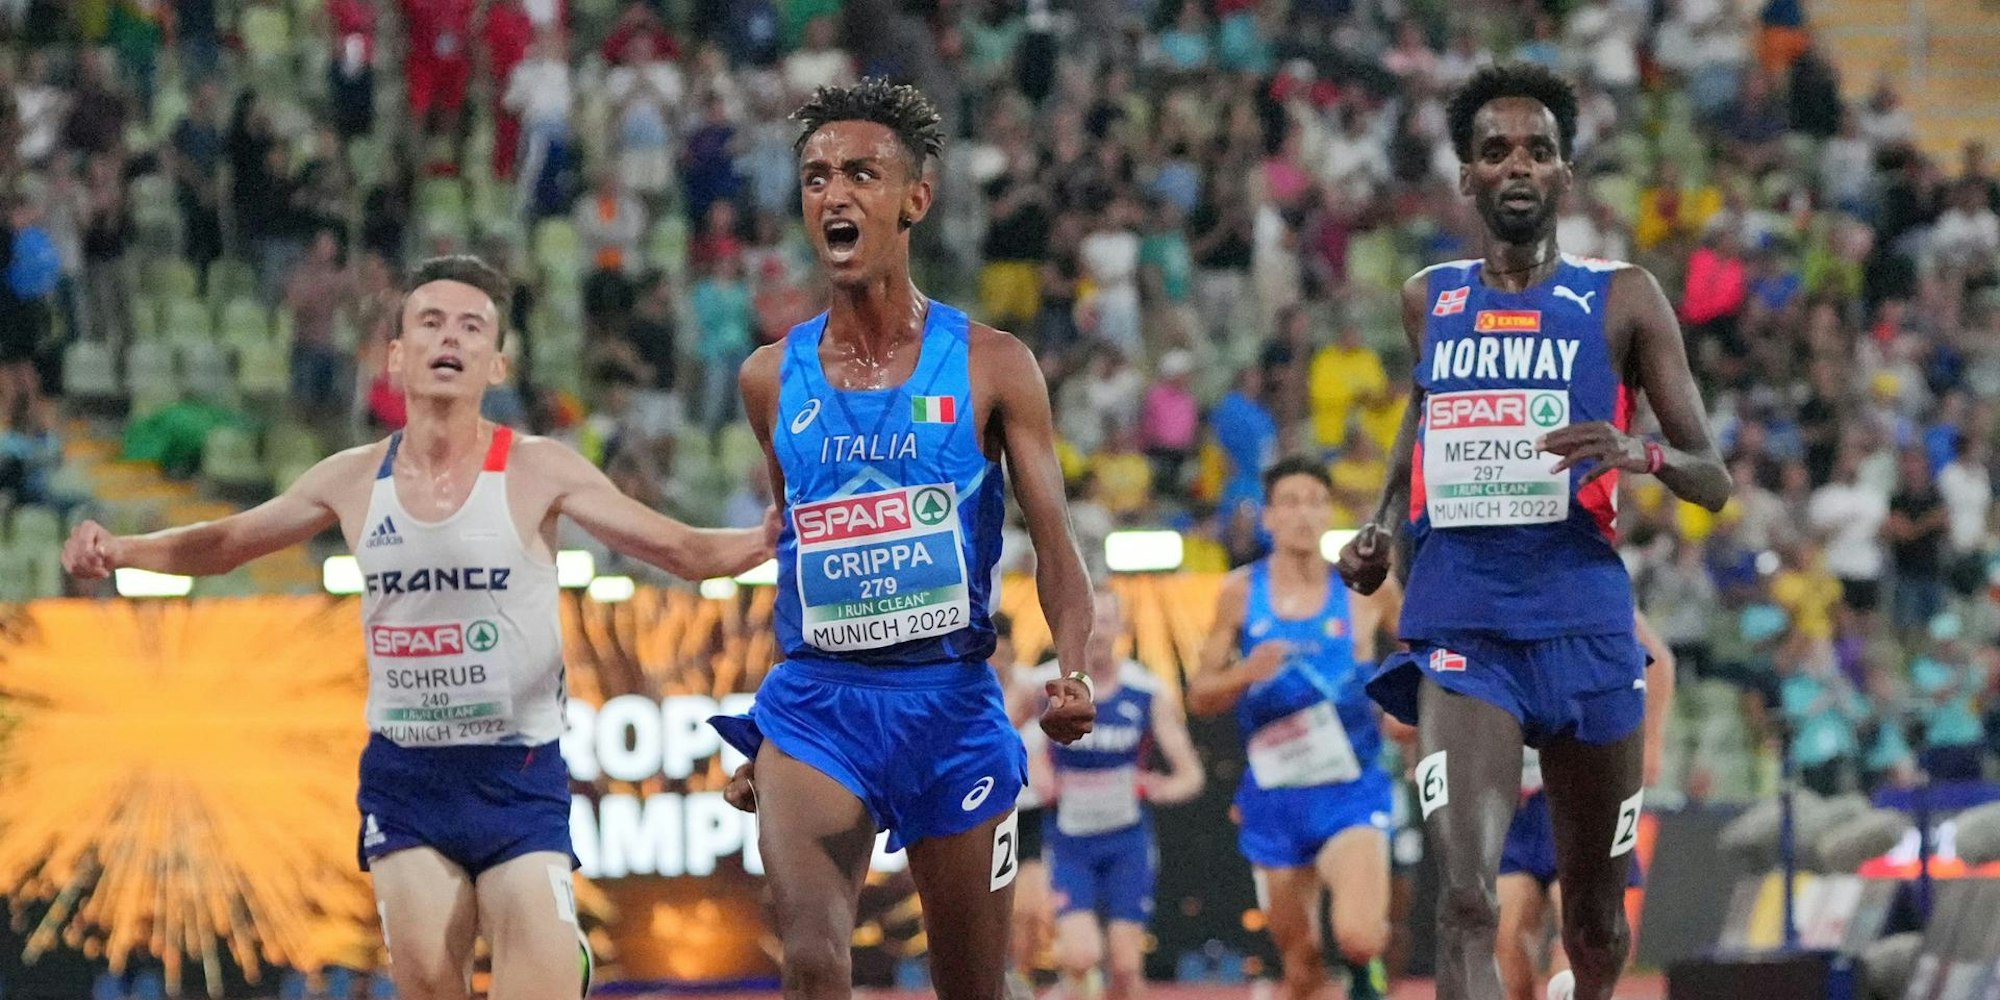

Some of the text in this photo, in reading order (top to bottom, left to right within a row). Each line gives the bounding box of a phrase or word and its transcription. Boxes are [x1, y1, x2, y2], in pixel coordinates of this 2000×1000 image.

[1431, 336, 1581, 382] NORWAY
[1432, 397, 1524, 427] SPAR
[821, 432, 918, 464] ITALIA
[1474, 466, 1504, 481] 297
[1459, 484, 1483, 496] RUN
[799, 497, 908, 540] SPAR
[1434, 500, 1558, 520] MUNICH 2022
[366, 536, 403, 549] adidas
[823, 541, 933, 581] CRIPPA
[365, 567, 511, 597] FRANCE
[859, 576, 897, 599] 279
[845, 602, 874, 617] RUN
[813, 606, 960, 647] MUNICH 2022
[374, 627, 461, 654] SPAR
[386, 664, 487, 689] SCHRUB
[421, 692, 449, 708] 240
[458, 718, 506, 738] 2022
[1424, 764, 1443, 802] 6
[1617, 808, 1636, 845] 2
